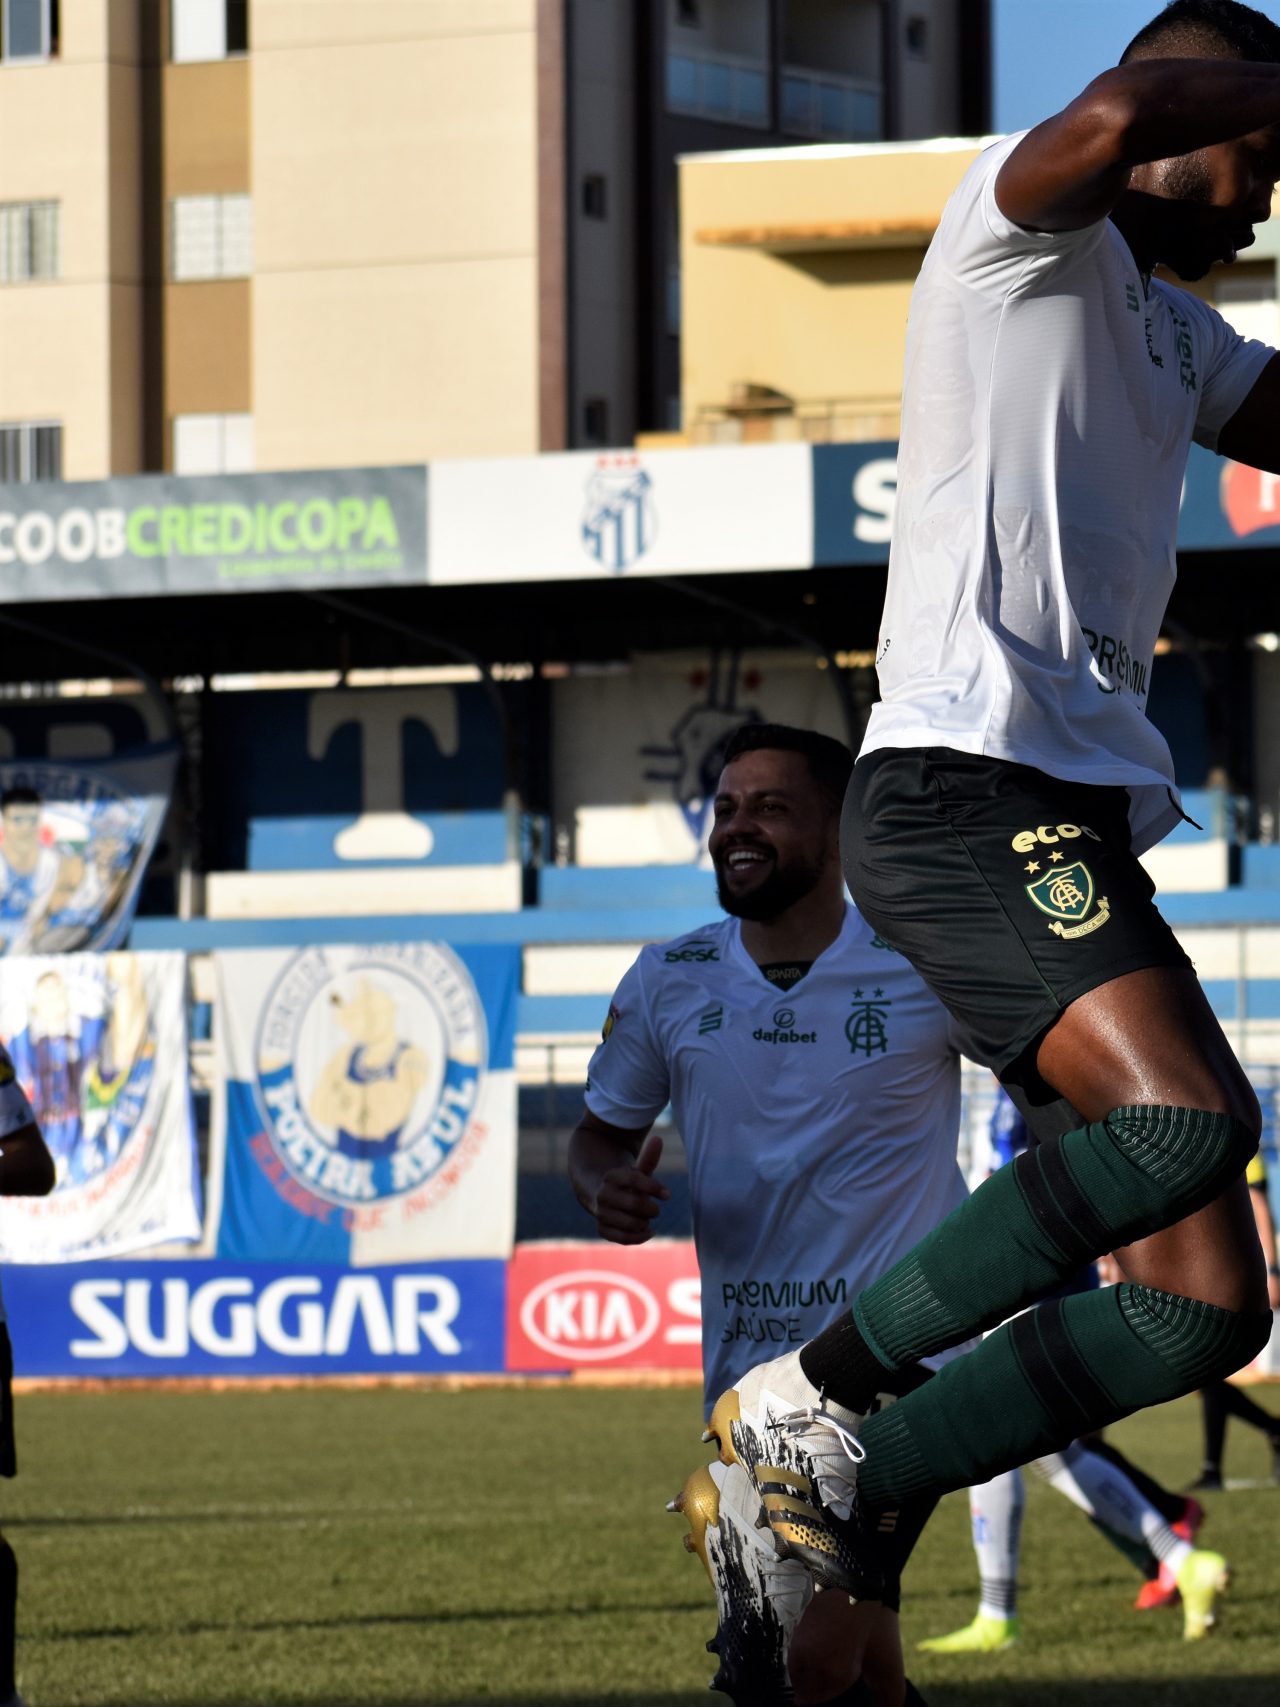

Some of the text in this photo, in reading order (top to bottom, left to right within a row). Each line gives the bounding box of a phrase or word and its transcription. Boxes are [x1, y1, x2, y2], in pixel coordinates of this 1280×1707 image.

[752, 1027, 818, 1045] dafabet
[68, 1275, 462, 1358] SUGGAR
[545, 1291, 638, 1339] KIA
